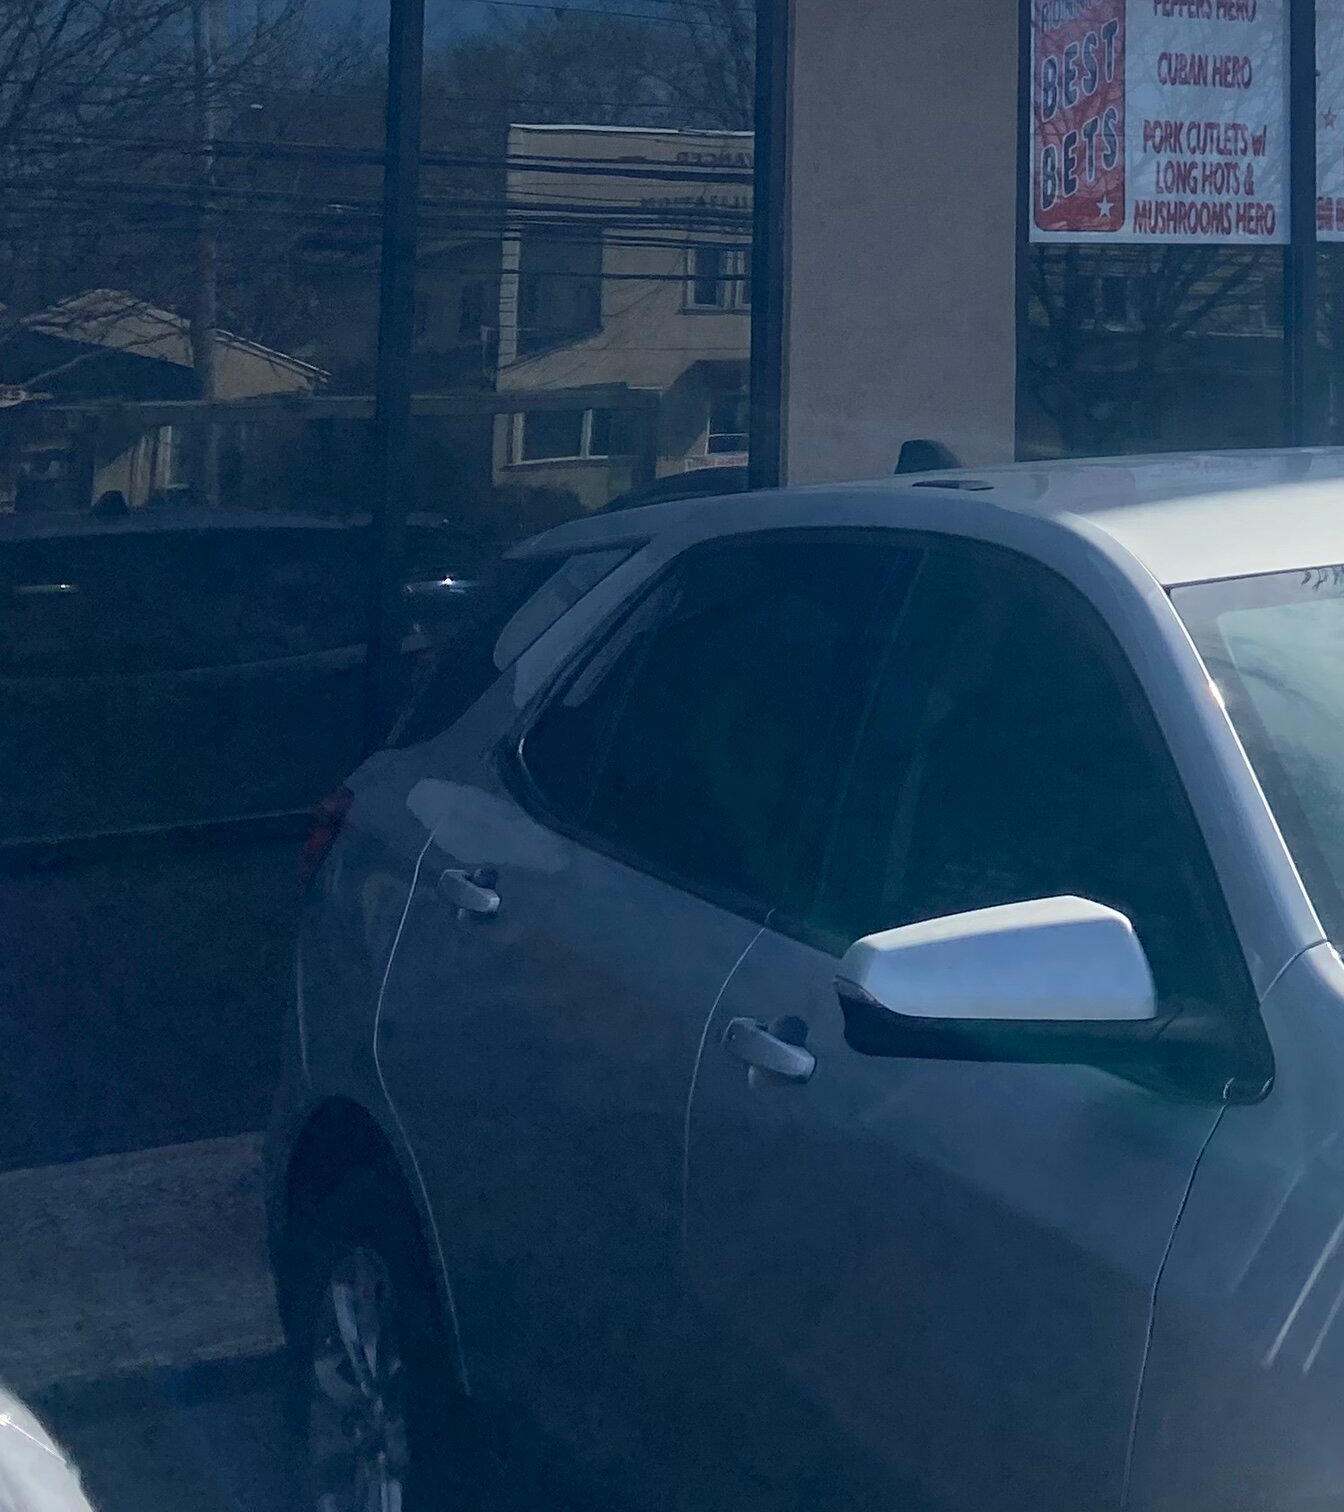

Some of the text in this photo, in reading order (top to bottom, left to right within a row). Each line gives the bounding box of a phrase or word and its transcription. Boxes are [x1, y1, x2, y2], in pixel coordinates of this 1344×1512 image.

[1041, 17, 1119, 123] BEST
[1157, 51, 1252, 88] CUBAN HERO
[1142, 119, 1184, 155] PORK
[1186, 121, 1249, 156] CUTLETS
[1040, 106, 1119, 211] BETS
[1155, 160, 1200, 195] LONG
[1201, 161, 1240, 196] HOTS
[1133, 199, 1276, 236] MUSHROOMS HERO
